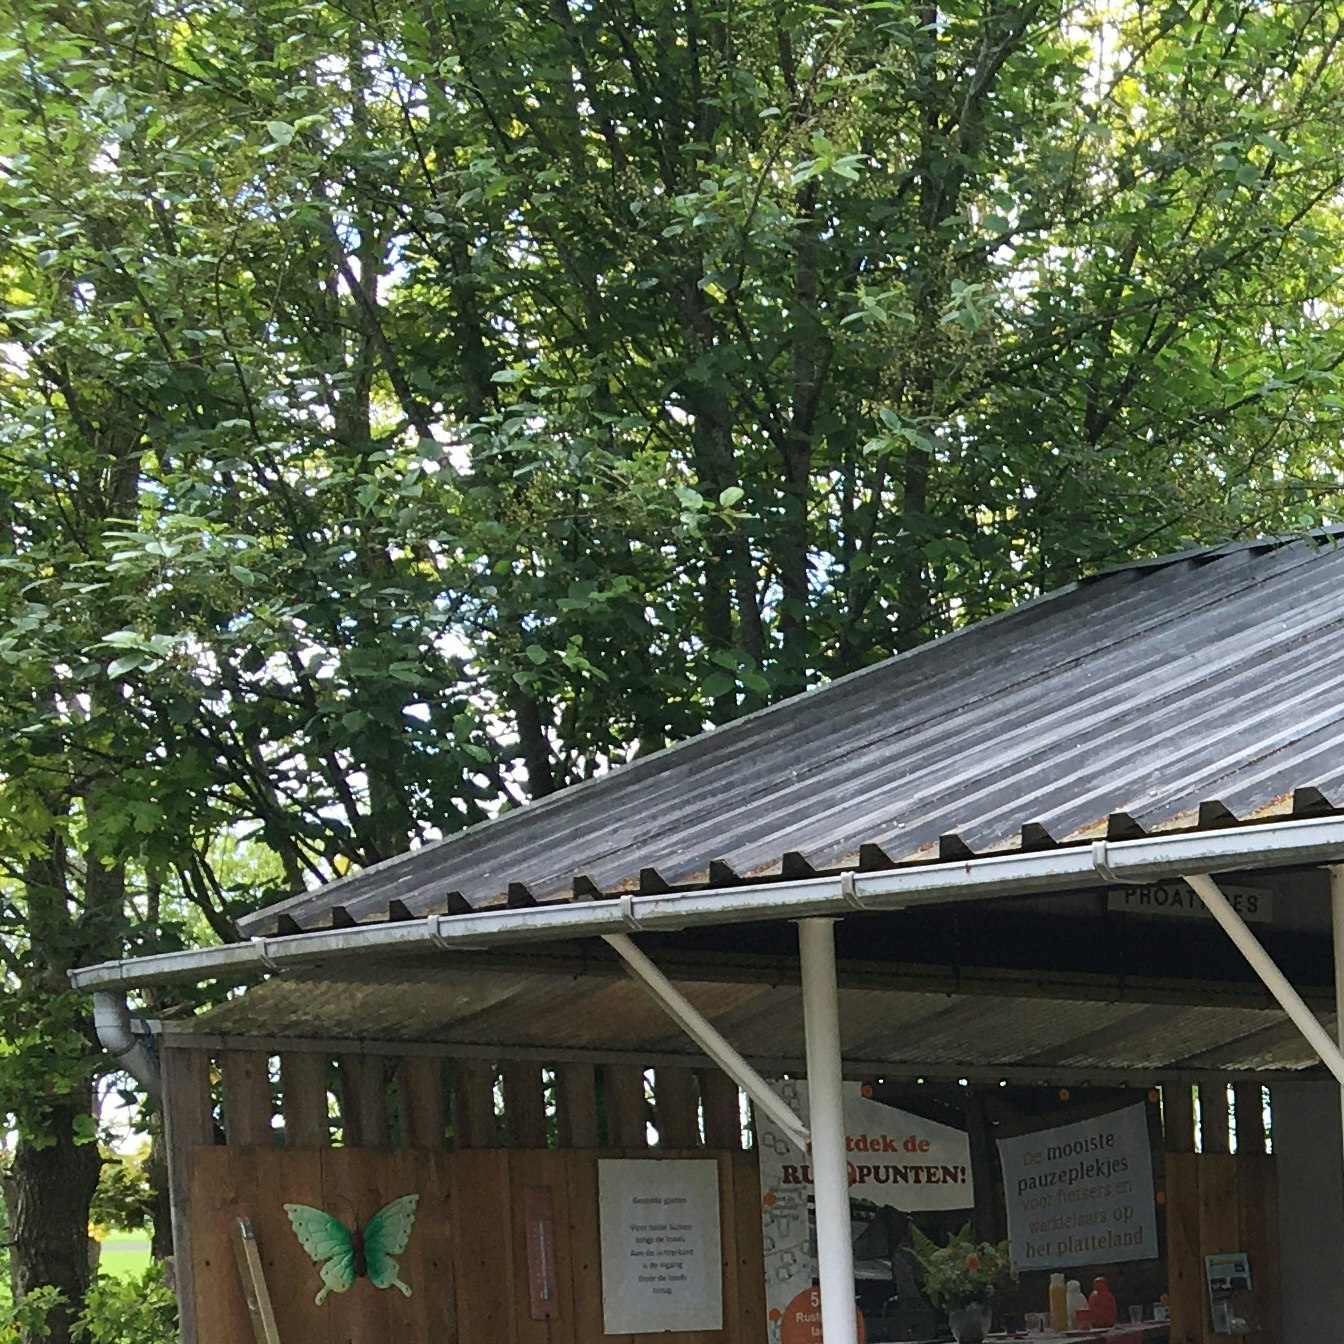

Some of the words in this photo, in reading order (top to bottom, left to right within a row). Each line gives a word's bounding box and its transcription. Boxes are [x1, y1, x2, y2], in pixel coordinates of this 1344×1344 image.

[807, 1133, 899, 1156] tdek
[903, 1133, 931, 1154] de
[1047, 1132, 1115, 1161] mooiste
[782, 1163, 967, 1185] RUPUNTEN!
[1017, 1155, 1129, 1196] pauzeplekjes
[1113, 1204, 1135, 1224] op
[1025, 1240, 1051, 1259] het
[1057, 1225, 1144, 1257] platteland
